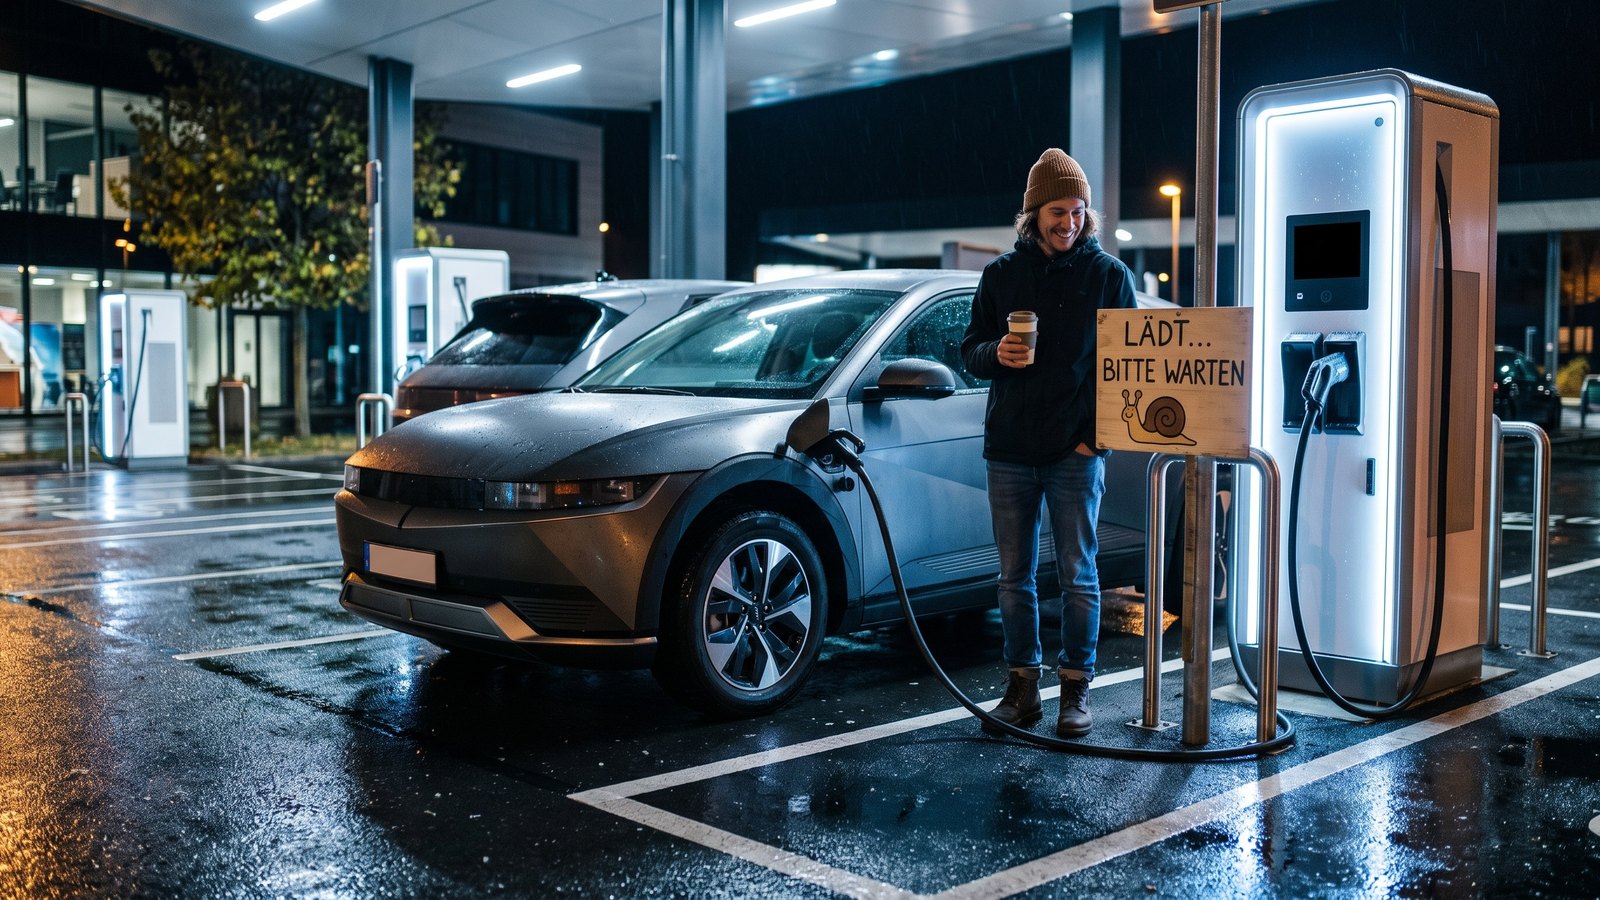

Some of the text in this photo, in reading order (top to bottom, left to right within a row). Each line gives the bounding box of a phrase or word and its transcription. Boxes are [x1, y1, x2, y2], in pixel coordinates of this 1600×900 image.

[1125, 315, 1211, 347] LÄDT...
[1103, 358, 1245, 386] BITTE WARTEN
